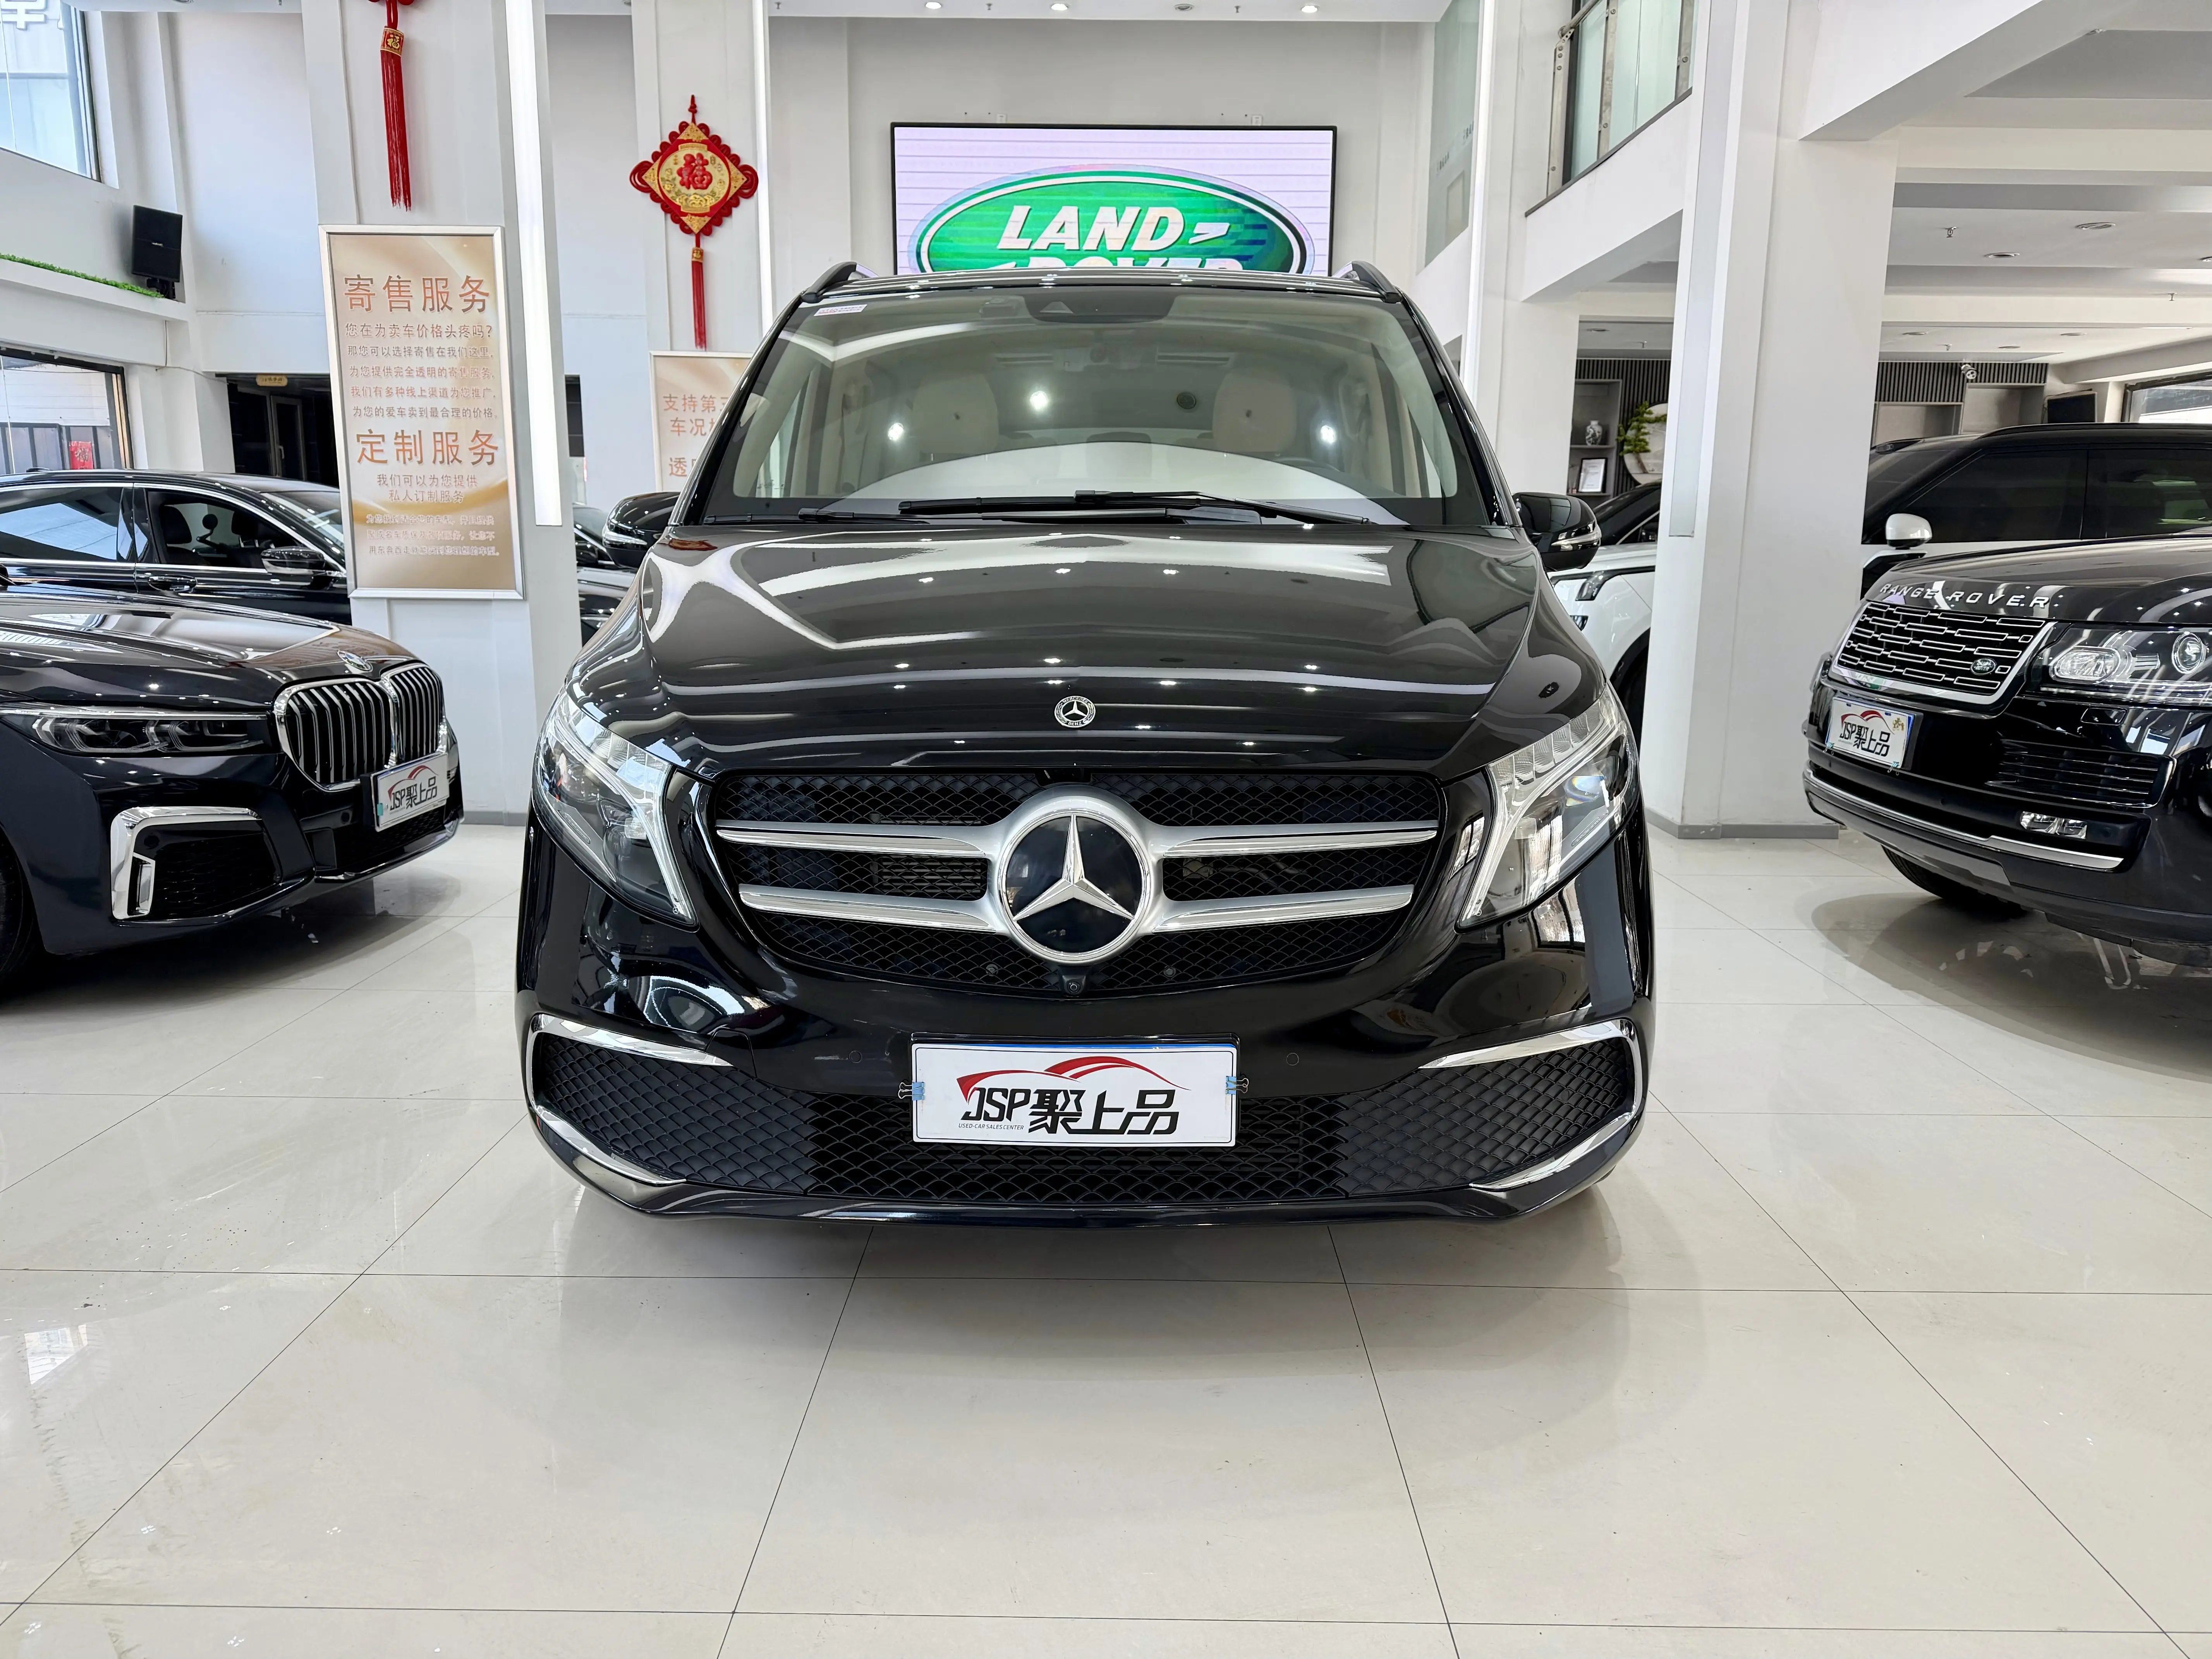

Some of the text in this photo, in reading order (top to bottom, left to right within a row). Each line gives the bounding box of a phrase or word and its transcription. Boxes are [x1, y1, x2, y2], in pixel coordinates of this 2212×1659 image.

[997, 205, 1185, 251] LAND
[344, 274, 489, 313] 寄售服务
[670, 417, 716, 436] 车况
[356, 428, 499, 466] 定制服务
[669, 457, 697, 477] 透
[377, 474, 478, 487] 我们可以为您提供
[389, 489, 464, 503] 私人订制服务
[1879, 583, 2050, 608] RANGE ROVER
